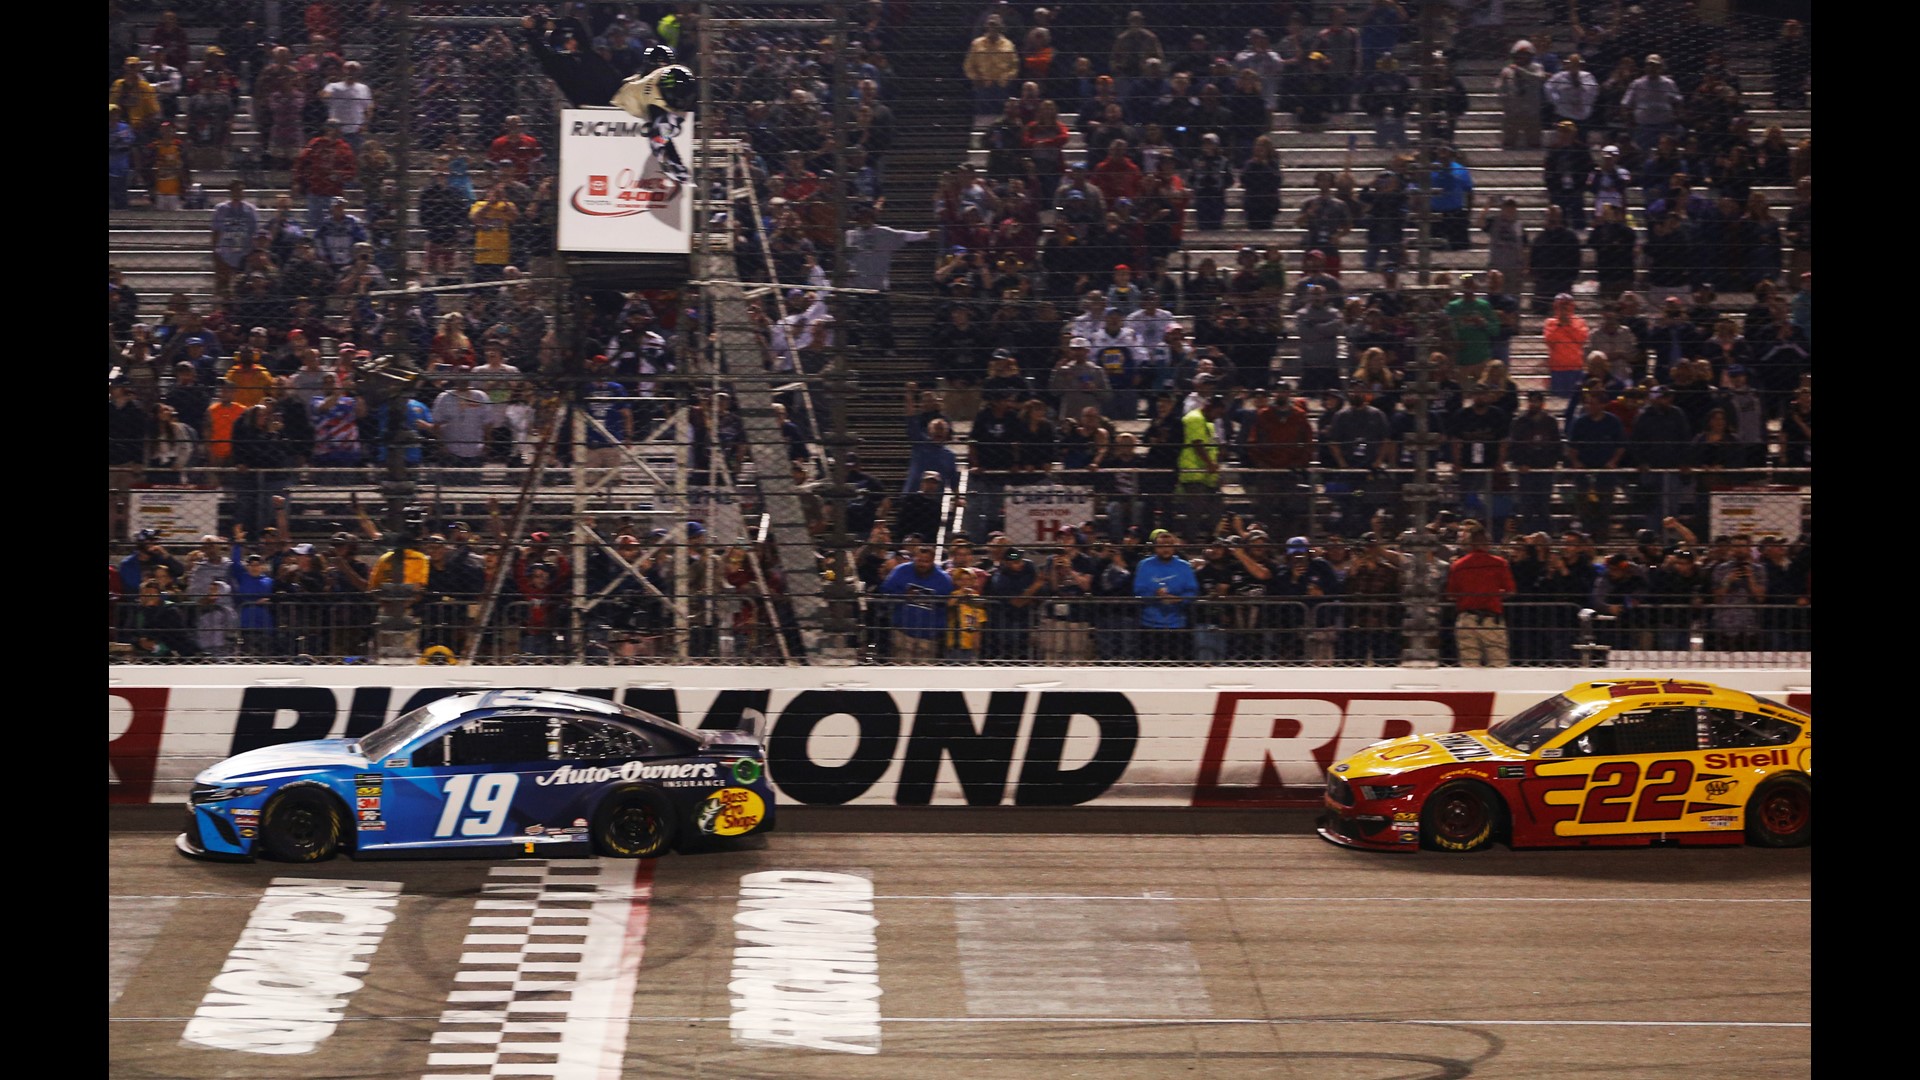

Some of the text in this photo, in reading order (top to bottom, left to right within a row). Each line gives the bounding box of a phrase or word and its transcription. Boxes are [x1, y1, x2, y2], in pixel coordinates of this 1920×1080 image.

[571, 121, 657, 137] RICHMO
[1036, 520, 1059, 541] H
[230, 687, 1140, 806] RIMOND
[1704, 749, 1790, 769] Shell
[536, 760, 718, 786] Auto-Owners
[663, 779, 726, 788] INSURANCE
[1578, 759, 1695, 824] 22
[357, 798, 379, 808] 3M
[433, 772, 519, 837] 19
[720, 790, 749, 804] Bass
[721, 802, 744, 816] Pro
[723, 815, 757, 830] Shops
